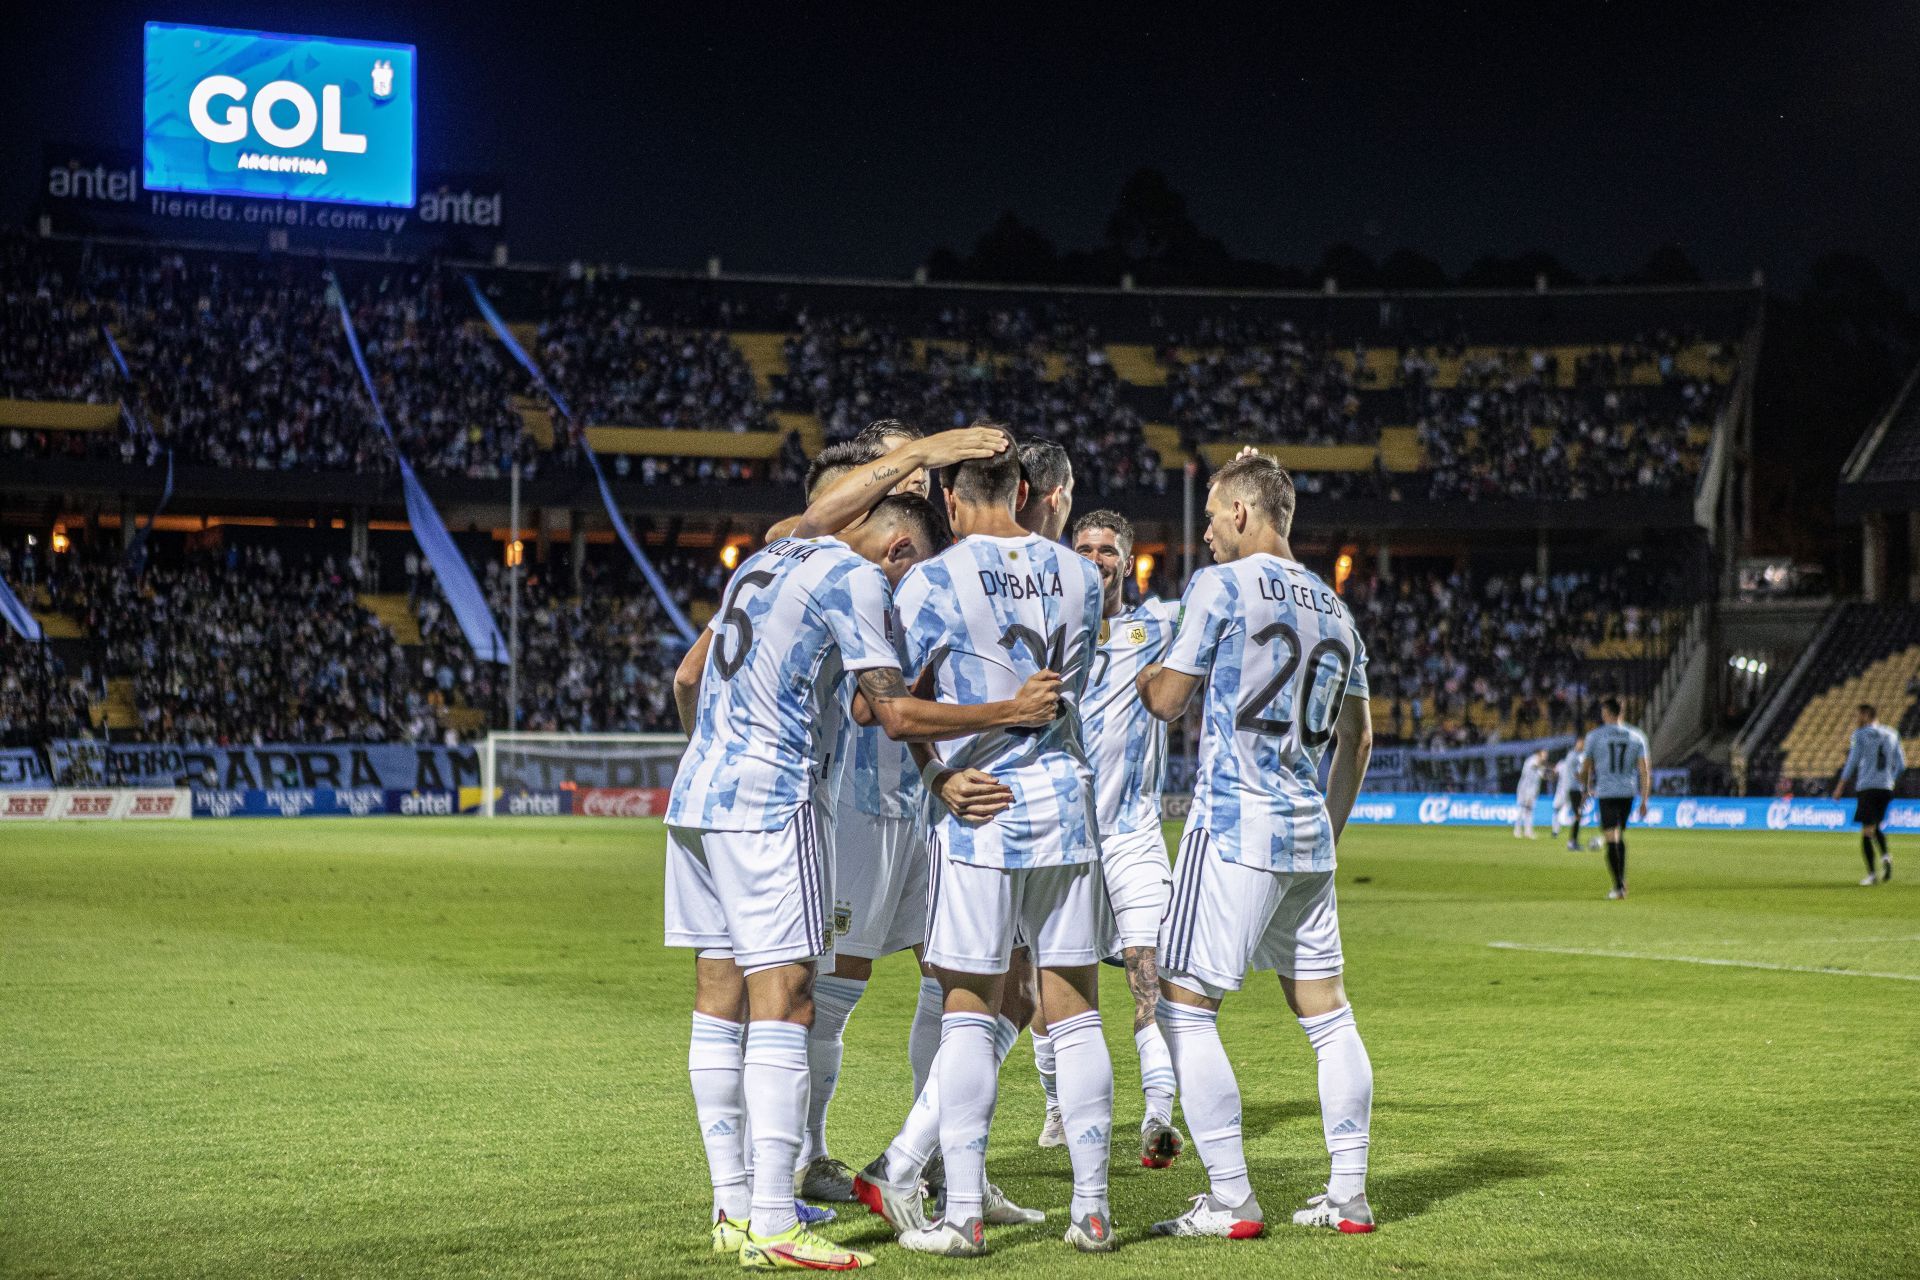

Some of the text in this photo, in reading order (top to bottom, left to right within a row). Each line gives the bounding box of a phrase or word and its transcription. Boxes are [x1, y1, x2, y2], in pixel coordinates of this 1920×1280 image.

[188, 74, 368, 154] GOL
[237, 152, 328, 175] ARGENTINA
[49, 163, 138, 201] antel
[418, 187, 501, 227] antel
[762, 538, 819, 563] OLINA
[977, 569, 1064, 600] DYBALA
[1258, 576, 1342, 619] LO CELSO
[1235, 621, 1342, 749] 20
[1608, 742, 1628, 774] 17
[400, 790, 453, 815] antel
